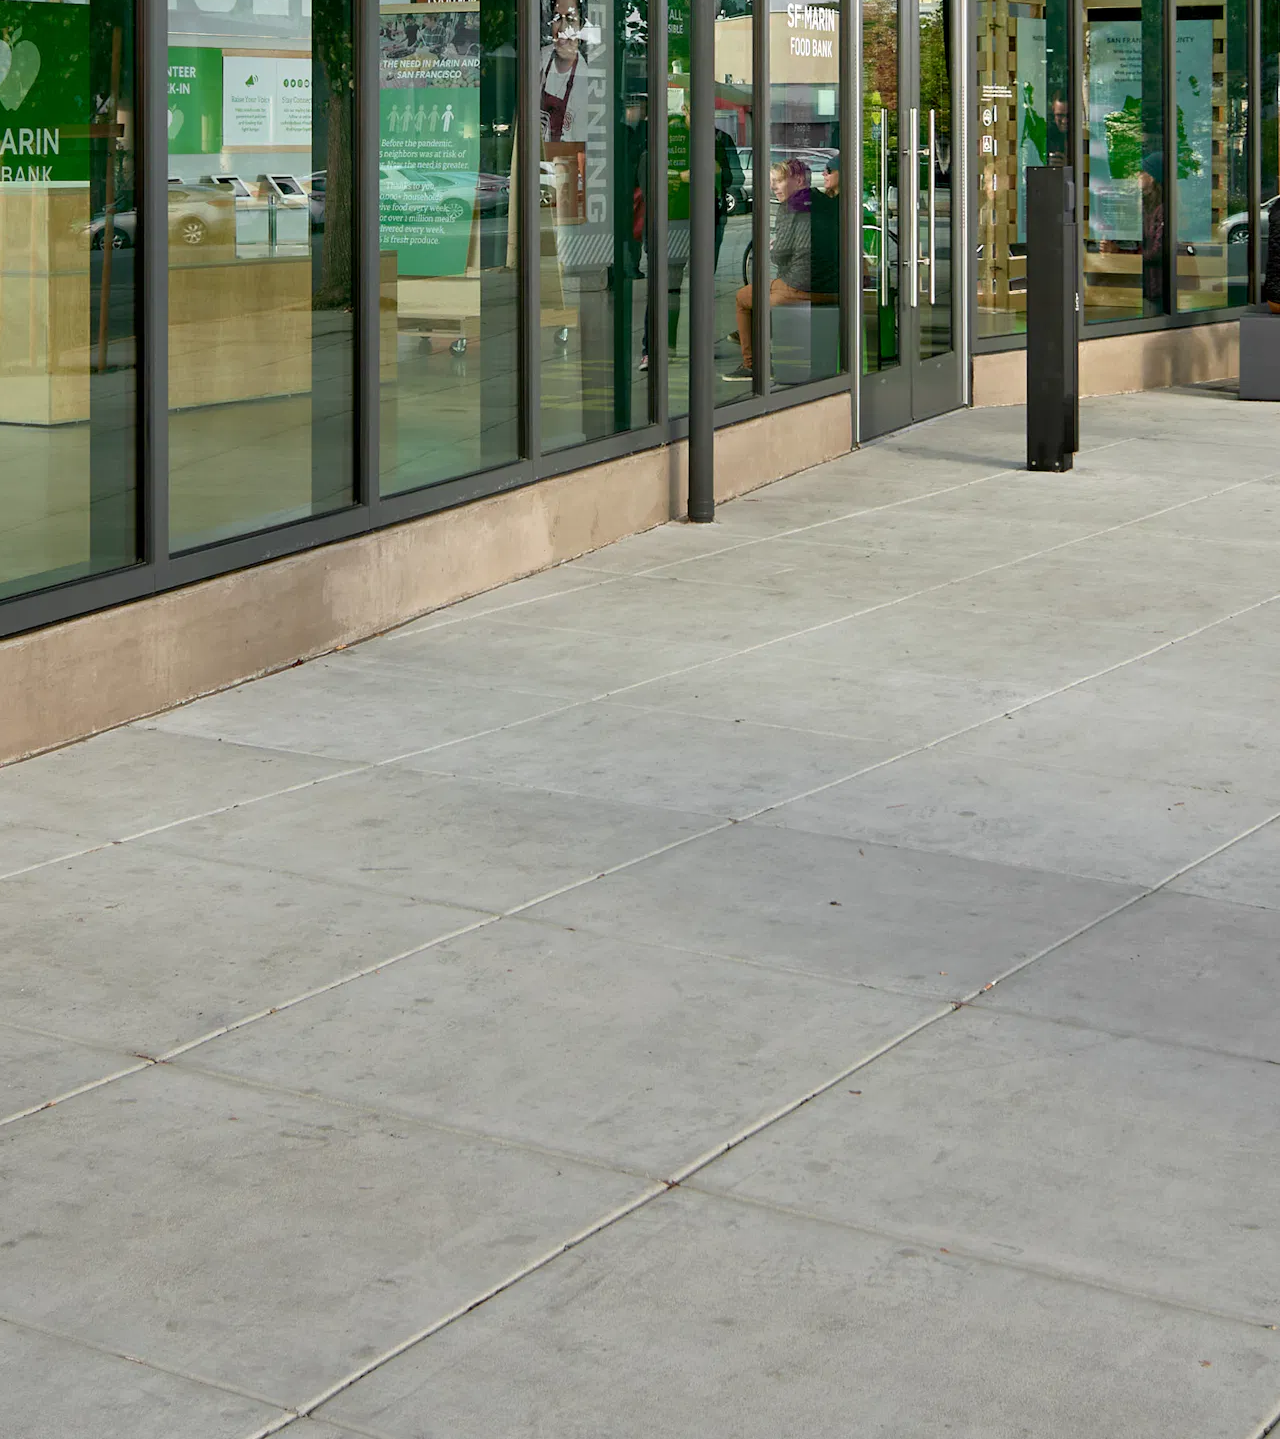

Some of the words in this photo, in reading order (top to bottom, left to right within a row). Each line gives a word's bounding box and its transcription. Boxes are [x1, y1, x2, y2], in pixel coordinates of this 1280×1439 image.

[790, 36, 811, 57] FOOD
[812, 38, 833, 58] BANK
[383, 60, 398, 68] THE
[399, 59, 421, 68] NEED
[422, 59, 431, 68] IN
[432, 59, 460, 67] MARIN
[461, 58, 480, 67] AND
[167, 65, 196, 78] NTEER
[396, 71, 413, 79] SAN
[414, 70, 462, 78] FRANCISCO
[167, 82, 191, 95] K-IN
[381, 139, 404, 147] Before
[404, 139, 417, 147] the
[384, 150, 418, 159] neighbors
[442, 150, 456, 158] risk
[457, 150, 467, 158] of
[1, 165, 53, 182] BANK
[409, 214, 434, 222] million
